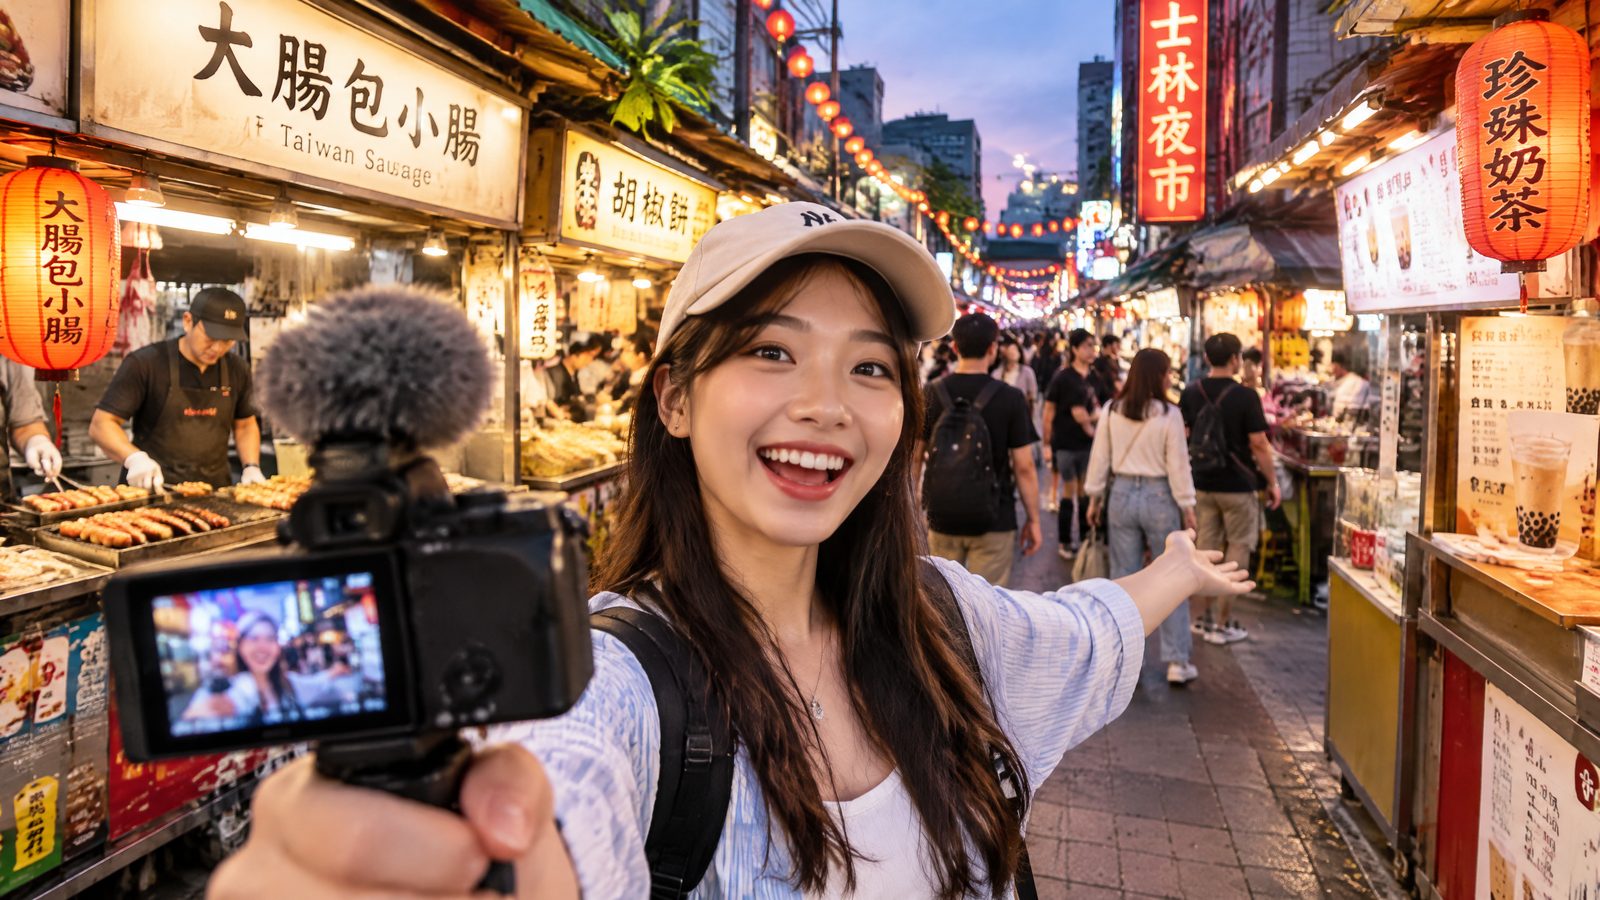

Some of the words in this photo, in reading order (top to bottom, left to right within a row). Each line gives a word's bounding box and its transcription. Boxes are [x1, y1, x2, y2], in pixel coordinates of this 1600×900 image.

[193, 1, 481, 167] 大腸包小腸
[280, 123, 354, 165] Taiwan
[1147, 1, 1200, 212] 士林夜市
[40, 190, 84, 347] 大腸包小腸
[612, 171, 689, 235] 胡椒餅
